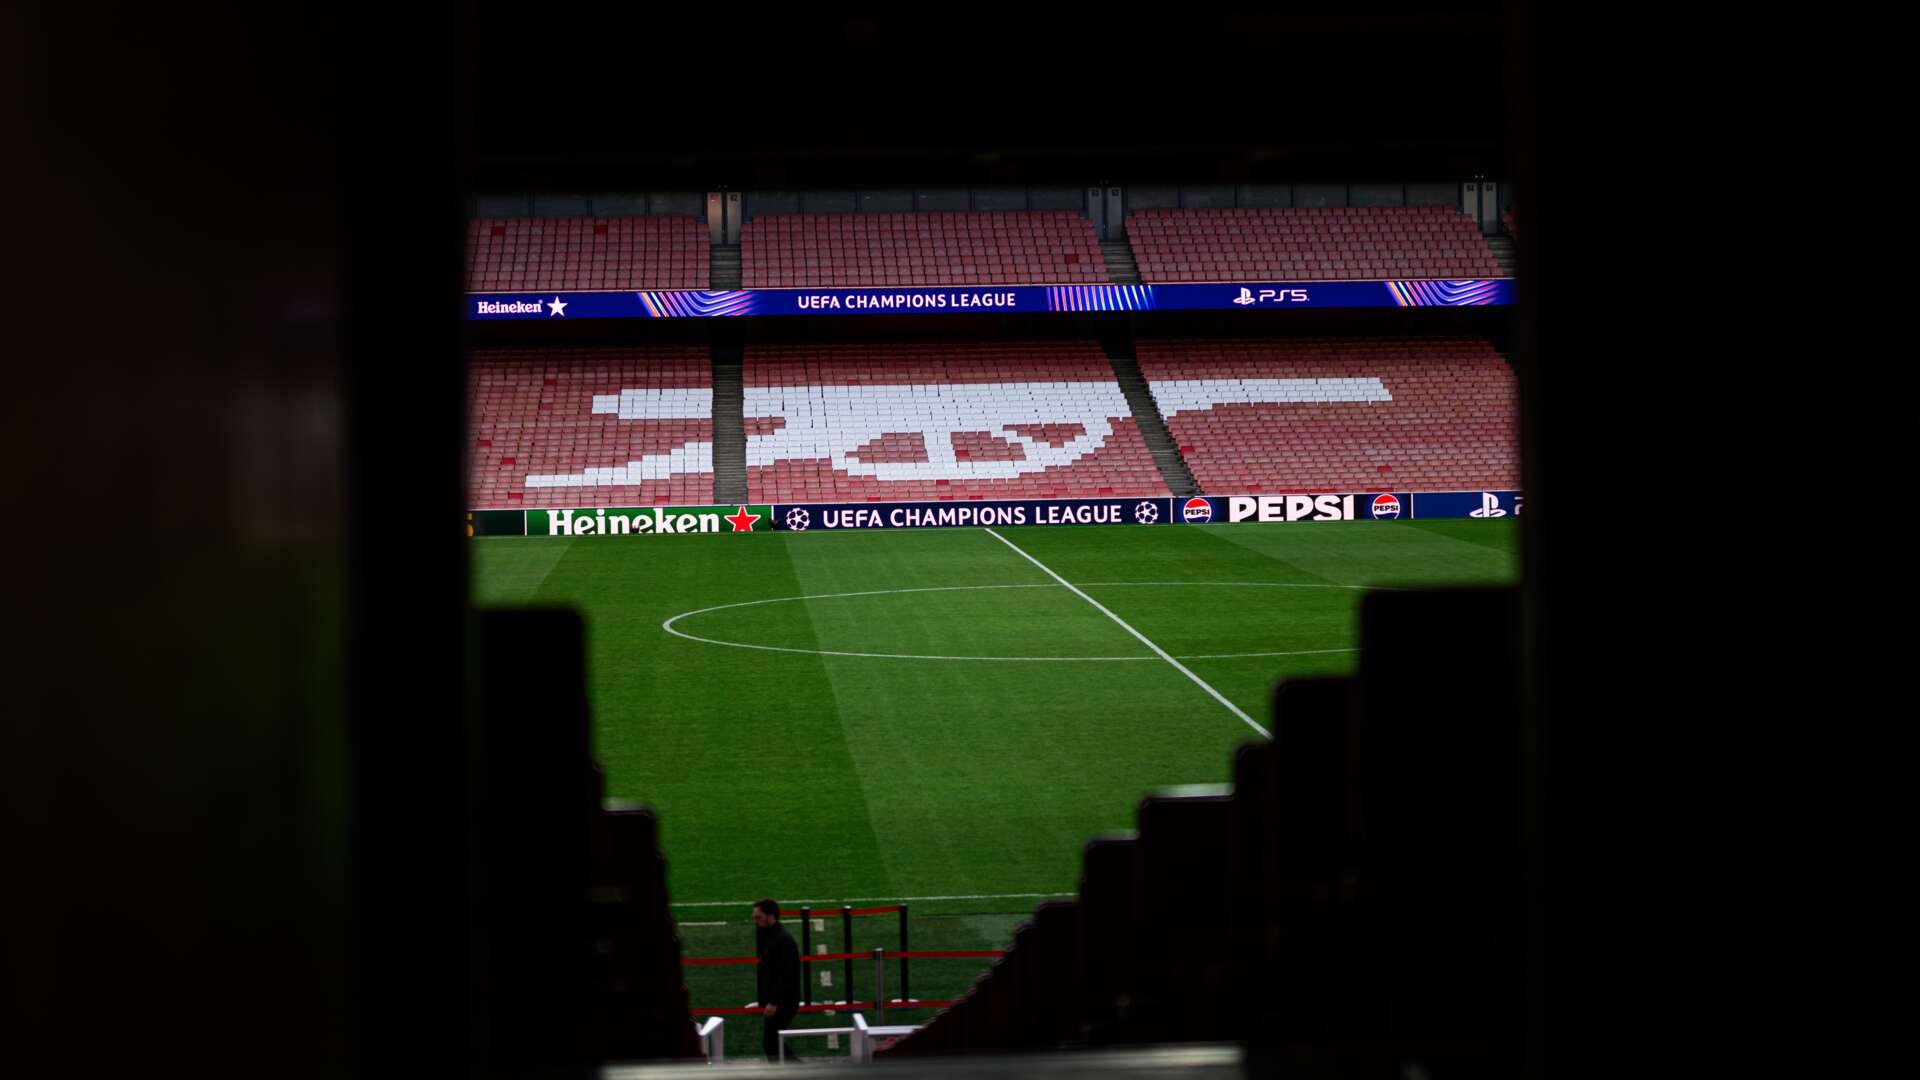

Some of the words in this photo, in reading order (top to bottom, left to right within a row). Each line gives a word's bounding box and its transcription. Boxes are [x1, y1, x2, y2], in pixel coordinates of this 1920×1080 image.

[797, 295, 841, 309] UEFA
[845, 294, 947, 309] CHAMPIONS
[951, 292, 1016, 307] LEAGUE
[1258, 289, 1309, 302] PS5
[477, 300, 542, 314] Heineken
[822, 509, 884, 528] UEFA
[889, 506, 1026, 527] CHAMPIONS
[1035, 504, 1122, 525] LEAGUE
[1228, 494, 1355, 523] PEPSI
[1373, 504, 1399, 512] PEPSI
[546, 508, 720, 536] Heineken
